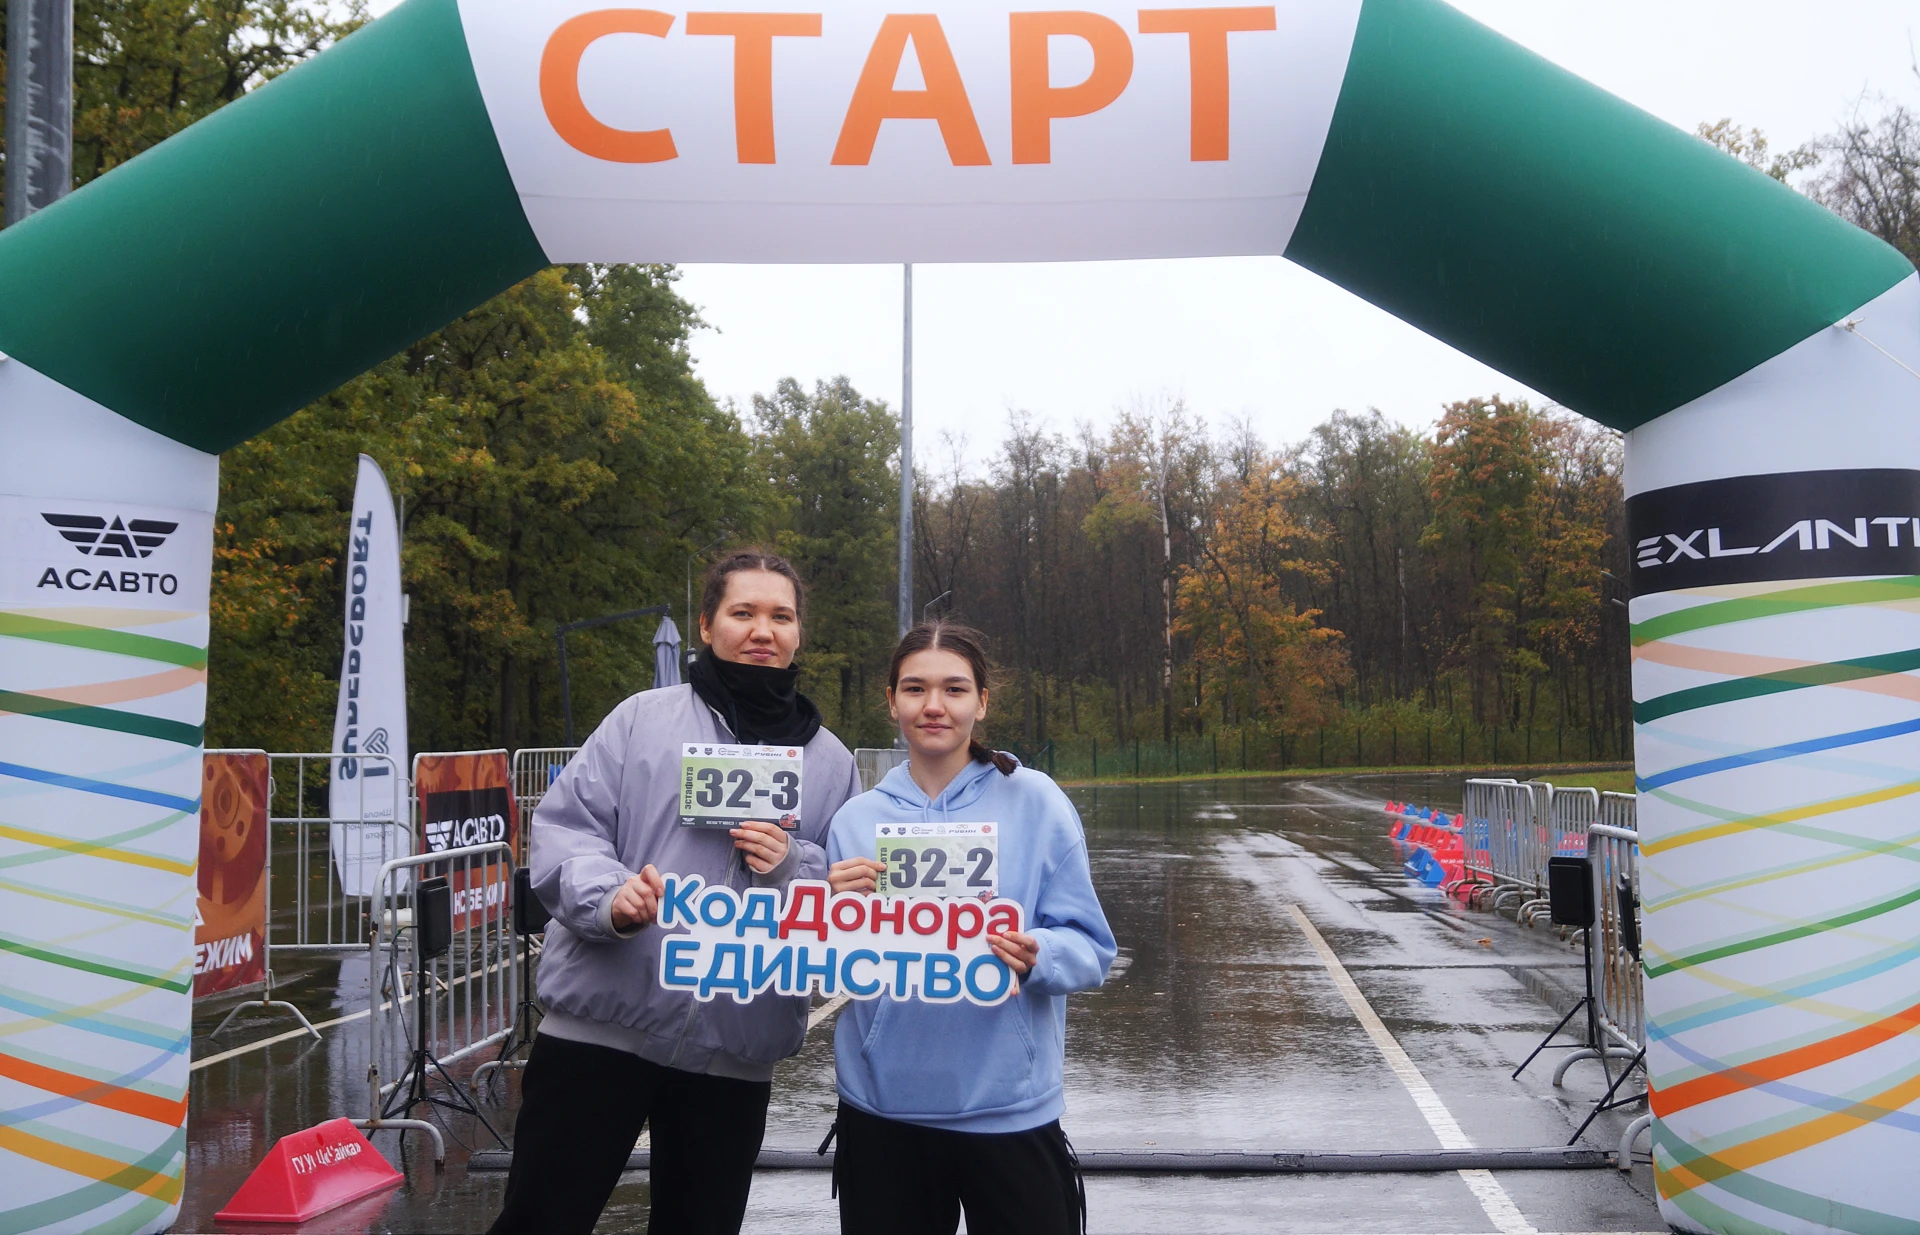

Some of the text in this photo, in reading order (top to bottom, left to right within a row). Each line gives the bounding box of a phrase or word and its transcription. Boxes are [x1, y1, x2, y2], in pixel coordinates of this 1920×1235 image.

[539, 5, 1277, 166] СТАРТ
[36, 567, 178, 595] АСАВТО
[684, 766, 694, 810] эстафета
[696, 767, 800, 811] 32-3
[879, 847, 888, 892] эстаета
[890, 847, 994, 889] 32-2
[662, 878, 1019, 950] КодДонора
[664, 940, 1011, 1001] ЕДИНСТВО
